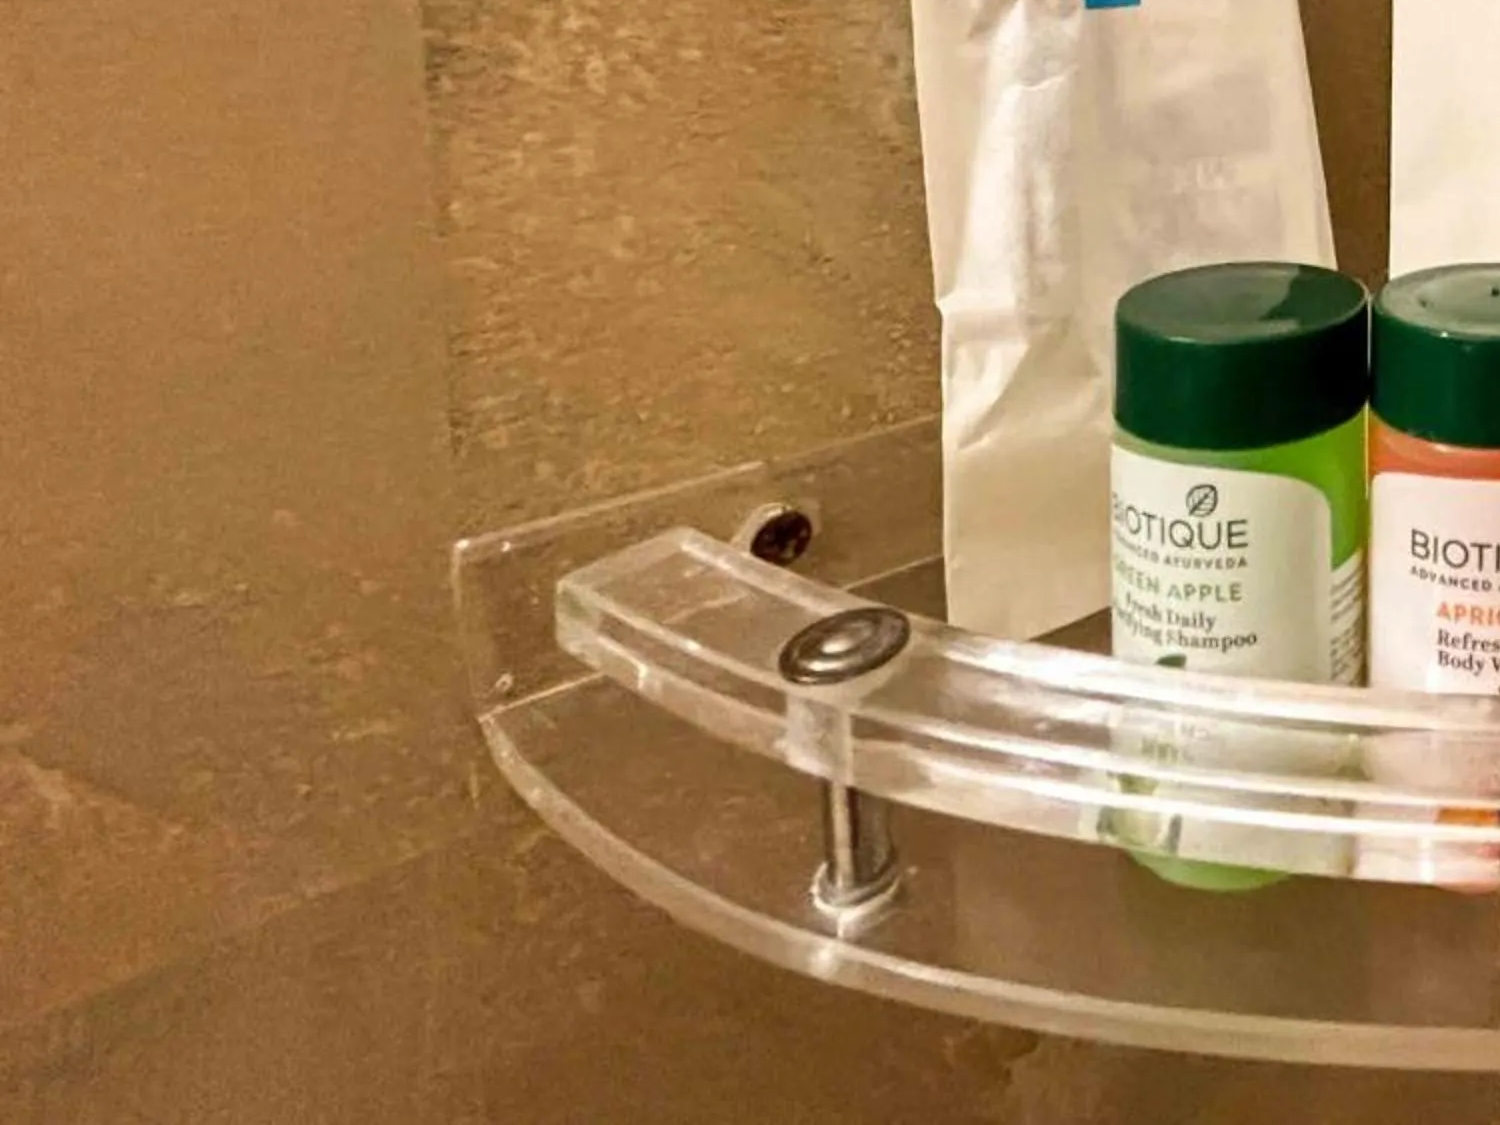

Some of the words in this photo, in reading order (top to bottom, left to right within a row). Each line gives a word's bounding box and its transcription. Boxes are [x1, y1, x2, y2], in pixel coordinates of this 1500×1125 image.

[1410, 565, 1492, 592] ADVANCED
[1167, 582, 1243, 603] APPLE
[1166, 609, 1217, 633] Daily
[1166, 629, 1258, 654] Shampoo
[1437, 650, 1485, 676] Body
